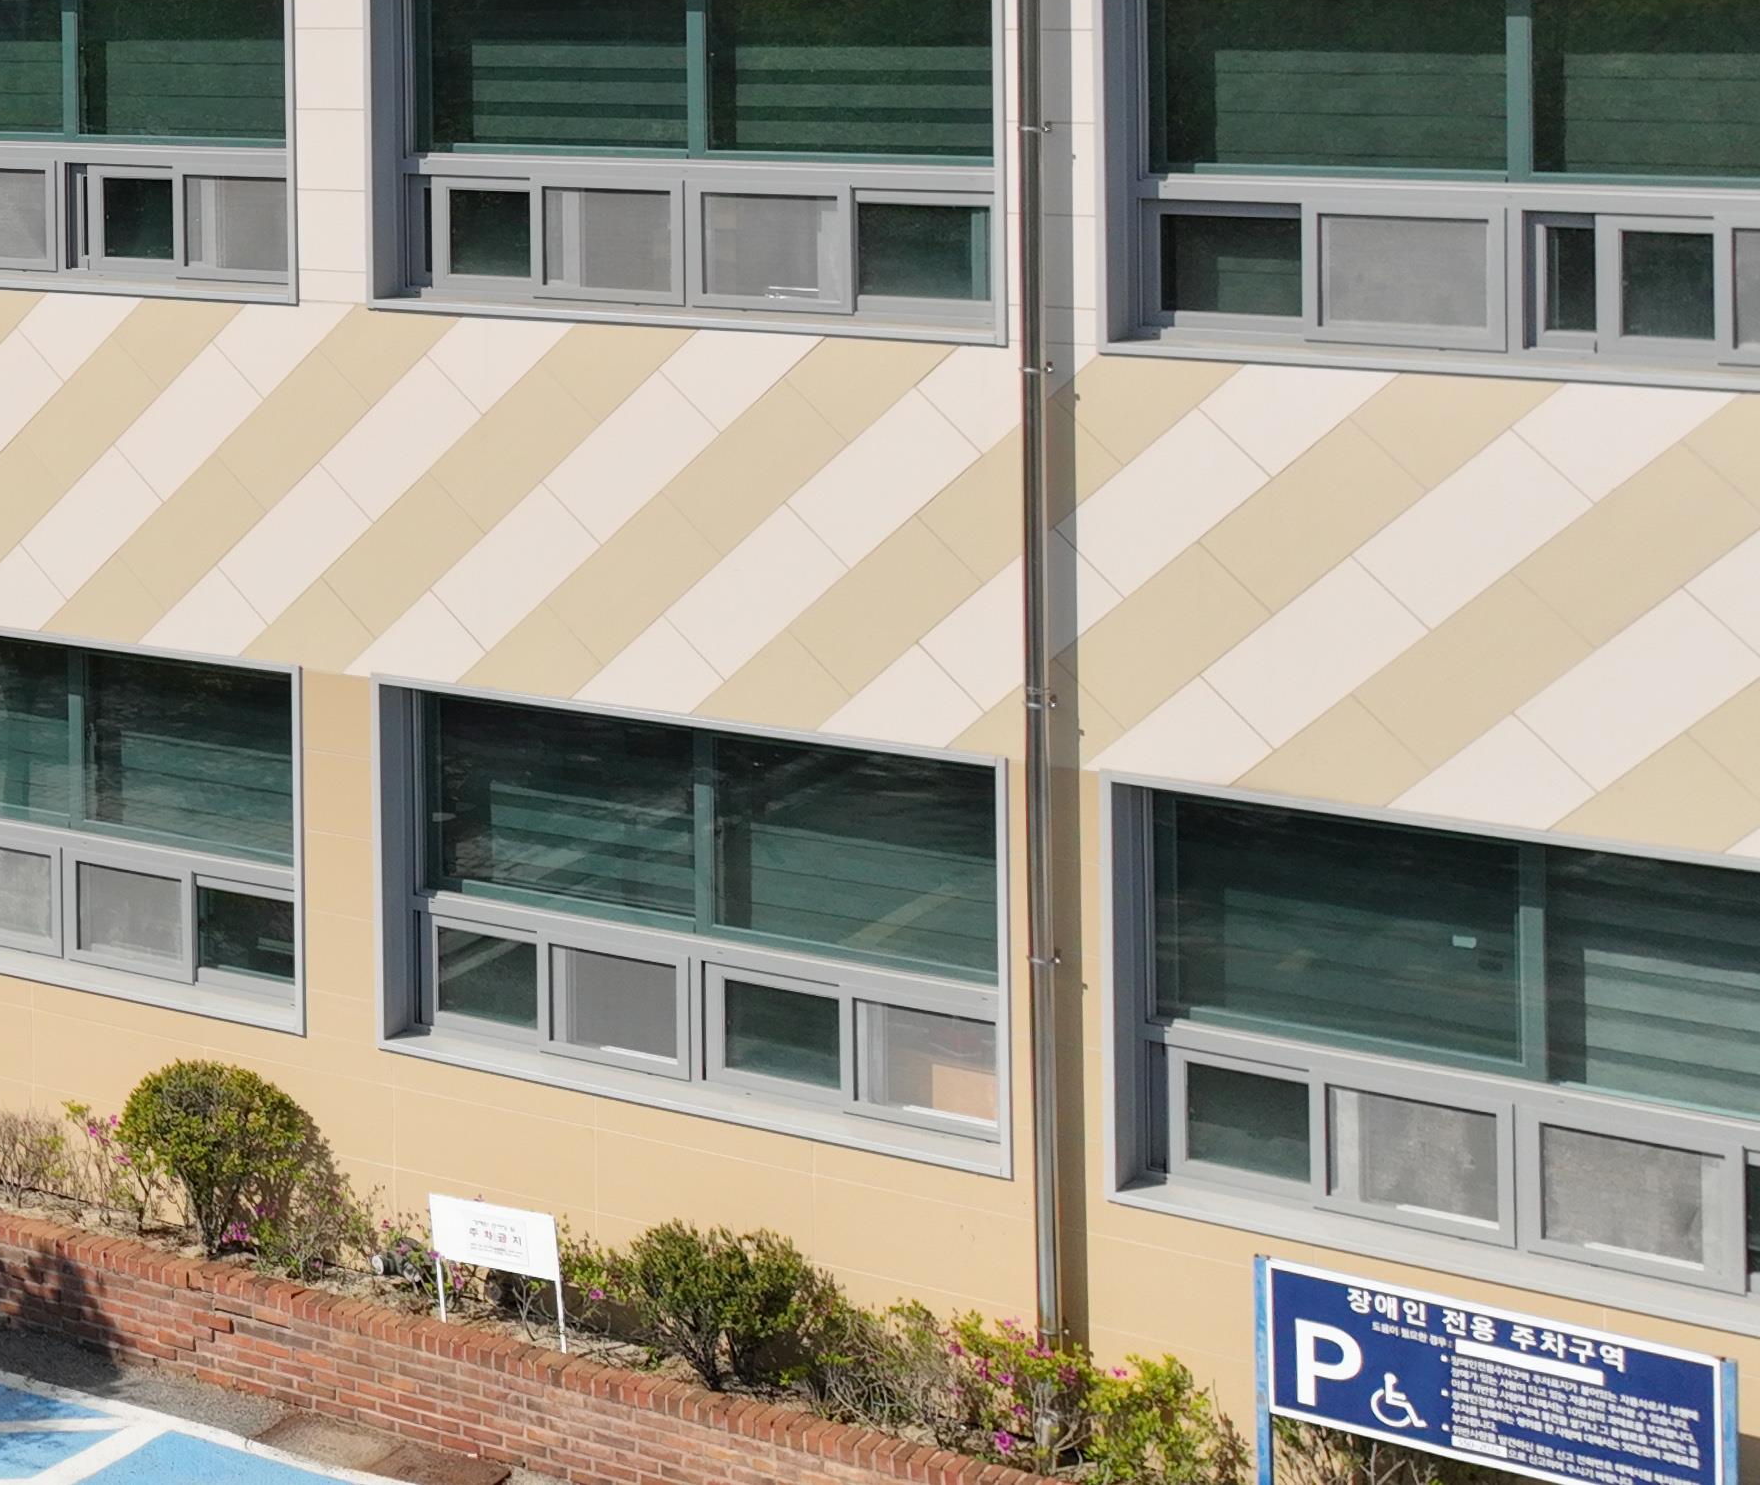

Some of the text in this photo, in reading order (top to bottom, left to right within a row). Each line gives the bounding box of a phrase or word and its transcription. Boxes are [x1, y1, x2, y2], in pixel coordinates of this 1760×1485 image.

[1295, 1318, 1363, 1406] P
[1346, 1287, 1626, 1373] 장애인 전용 주차구역
